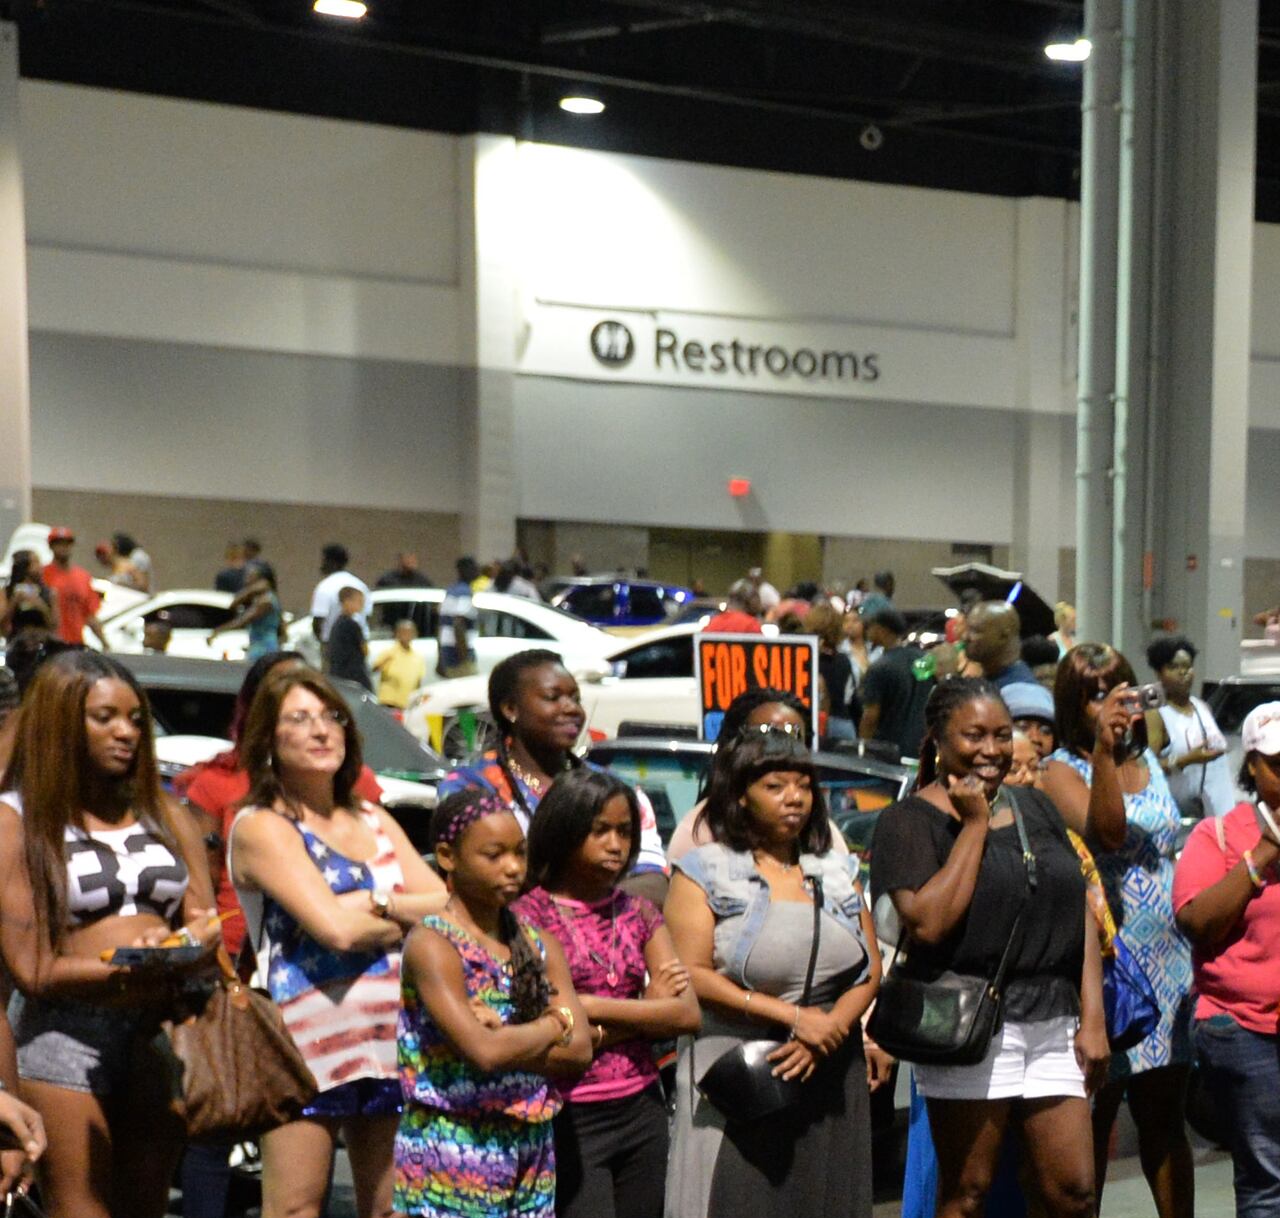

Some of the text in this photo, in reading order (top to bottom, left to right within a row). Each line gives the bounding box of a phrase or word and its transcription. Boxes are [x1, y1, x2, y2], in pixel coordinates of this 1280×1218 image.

[654, 328, 880, 382] Restrooms
[702, 642, 747, 711] FOR
[65, 833, 189, 917] 32
